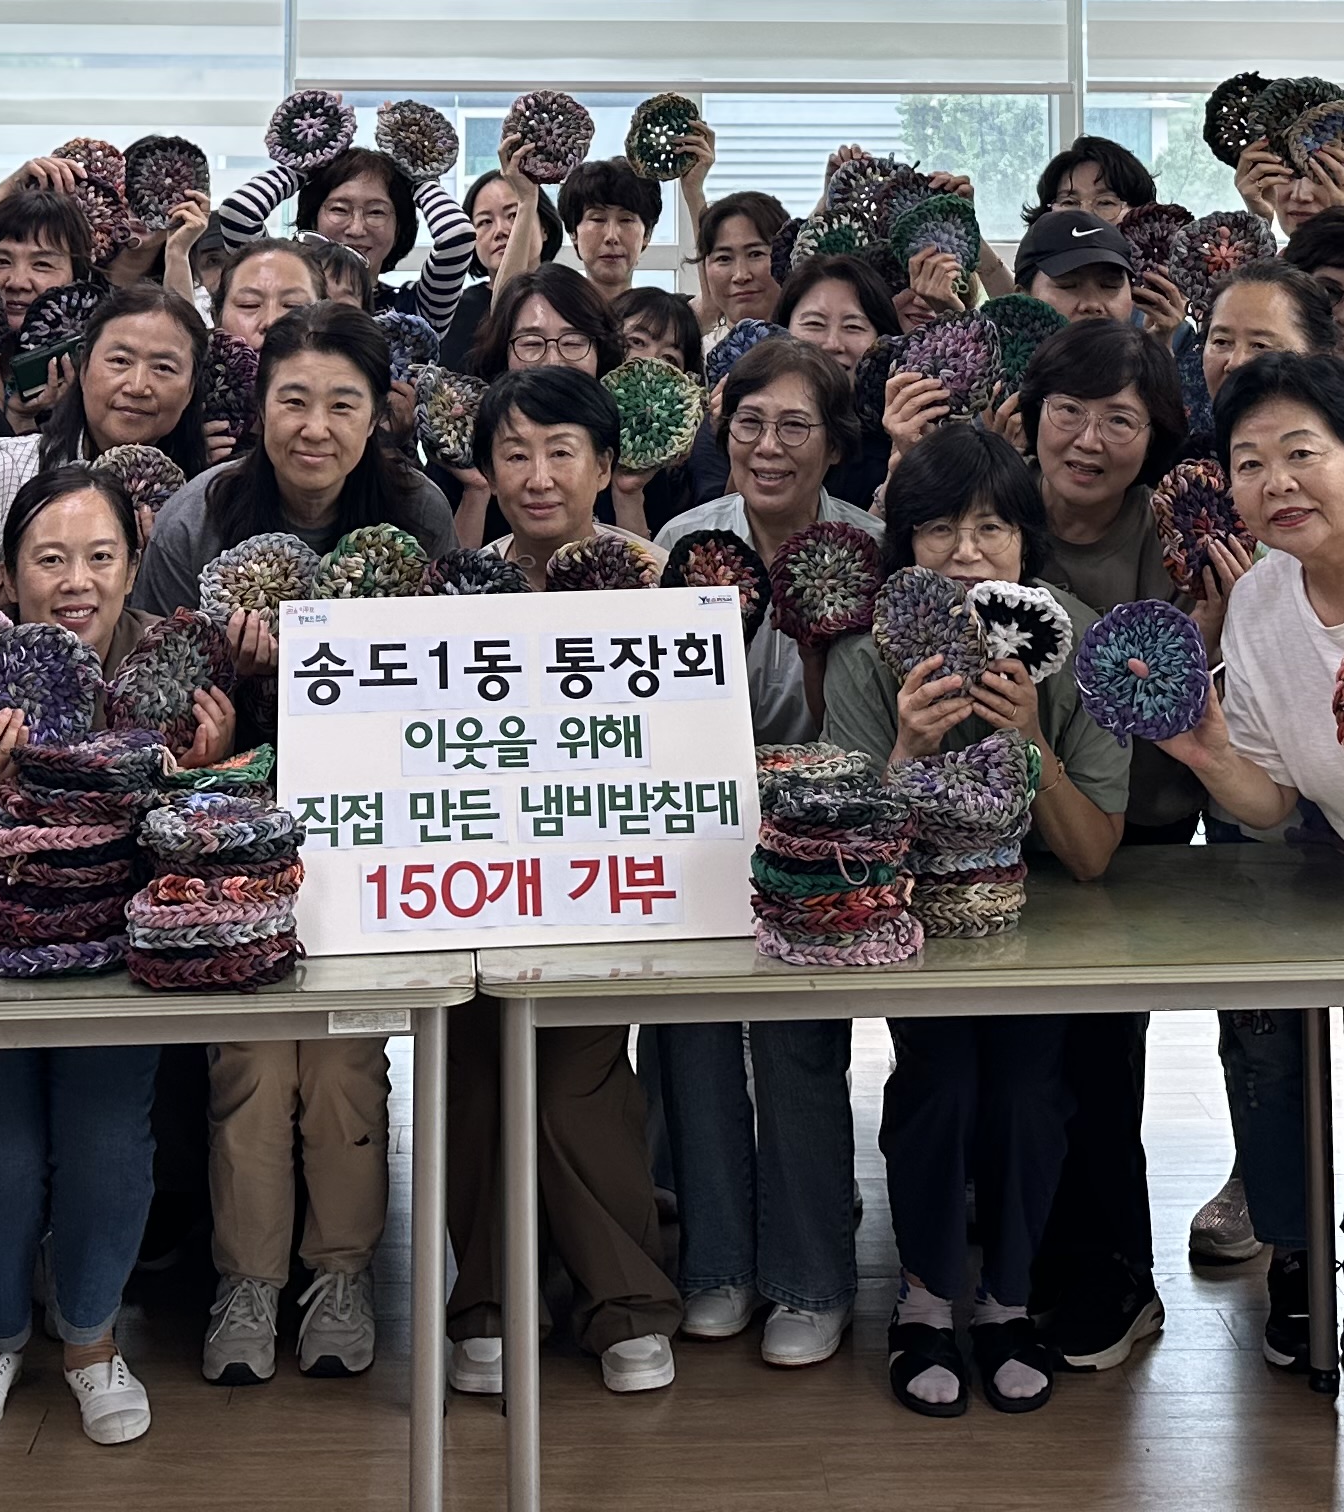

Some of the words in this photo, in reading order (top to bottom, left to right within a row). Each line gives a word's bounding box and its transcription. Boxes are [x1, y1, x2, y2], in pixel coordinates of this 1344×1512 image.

[293, 640, 523, 706] 송도1동
[545, 632, 727, 700] 통장회
[404, 715, 538, 770] 이웃을
[556, 714, 643, 760] 위해
[296, 791, 384, 847] 직접
[409, 788, 501, 843] 만든
[520, 780, 740, 838] 냄비받침대
[365, 857, 543, 920] 150개
[567, 854, 677, 916] 기부
